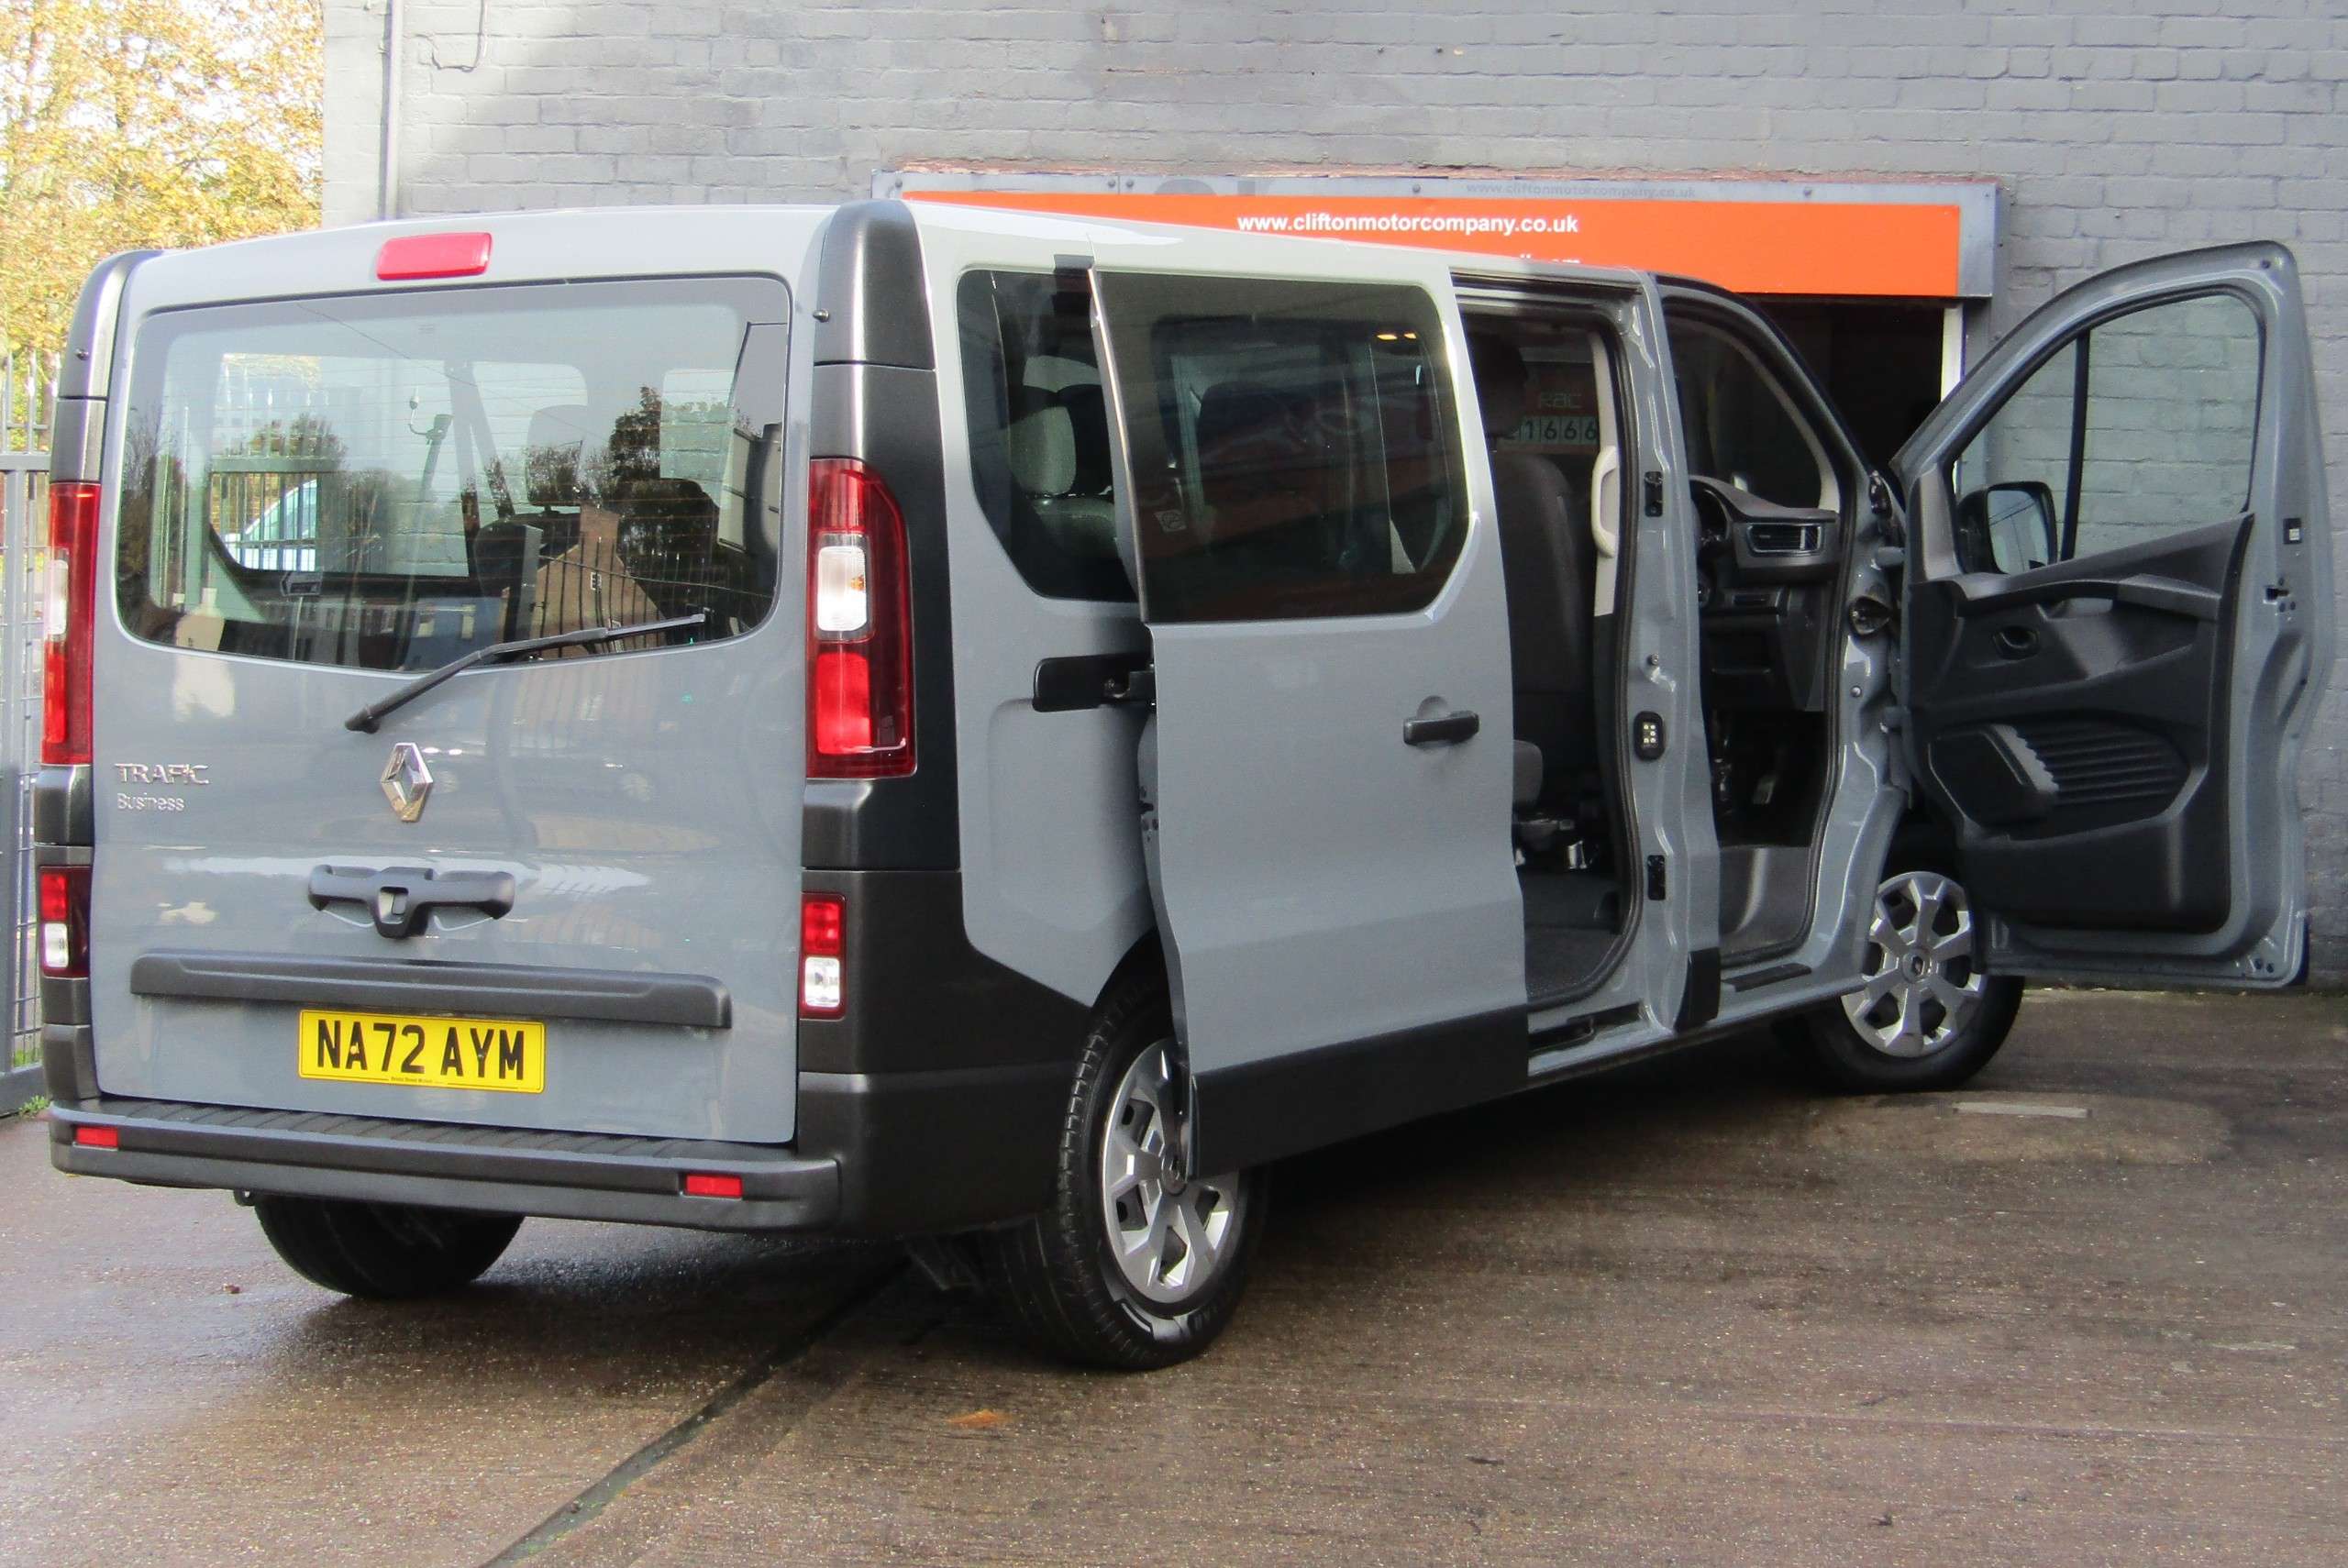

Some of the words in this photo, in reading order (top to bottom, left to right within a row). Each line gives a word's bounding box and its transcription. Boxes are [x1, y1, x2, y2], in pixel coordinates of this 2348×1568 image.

[1466, 182, 1696, 198] www.cliftonmotorcompany.co.uk
[1237, 213, 1578, 237] www.cliftonmotorcompany.co.uk
[1504, 419, 1597, 441] 1666
[114, 763, 210, 785] TRAFIC
[116, 792, 185, 812] Business
[317, 1019, 426, 1075] NA72
[440, 1026, 524, 1081] AYM
